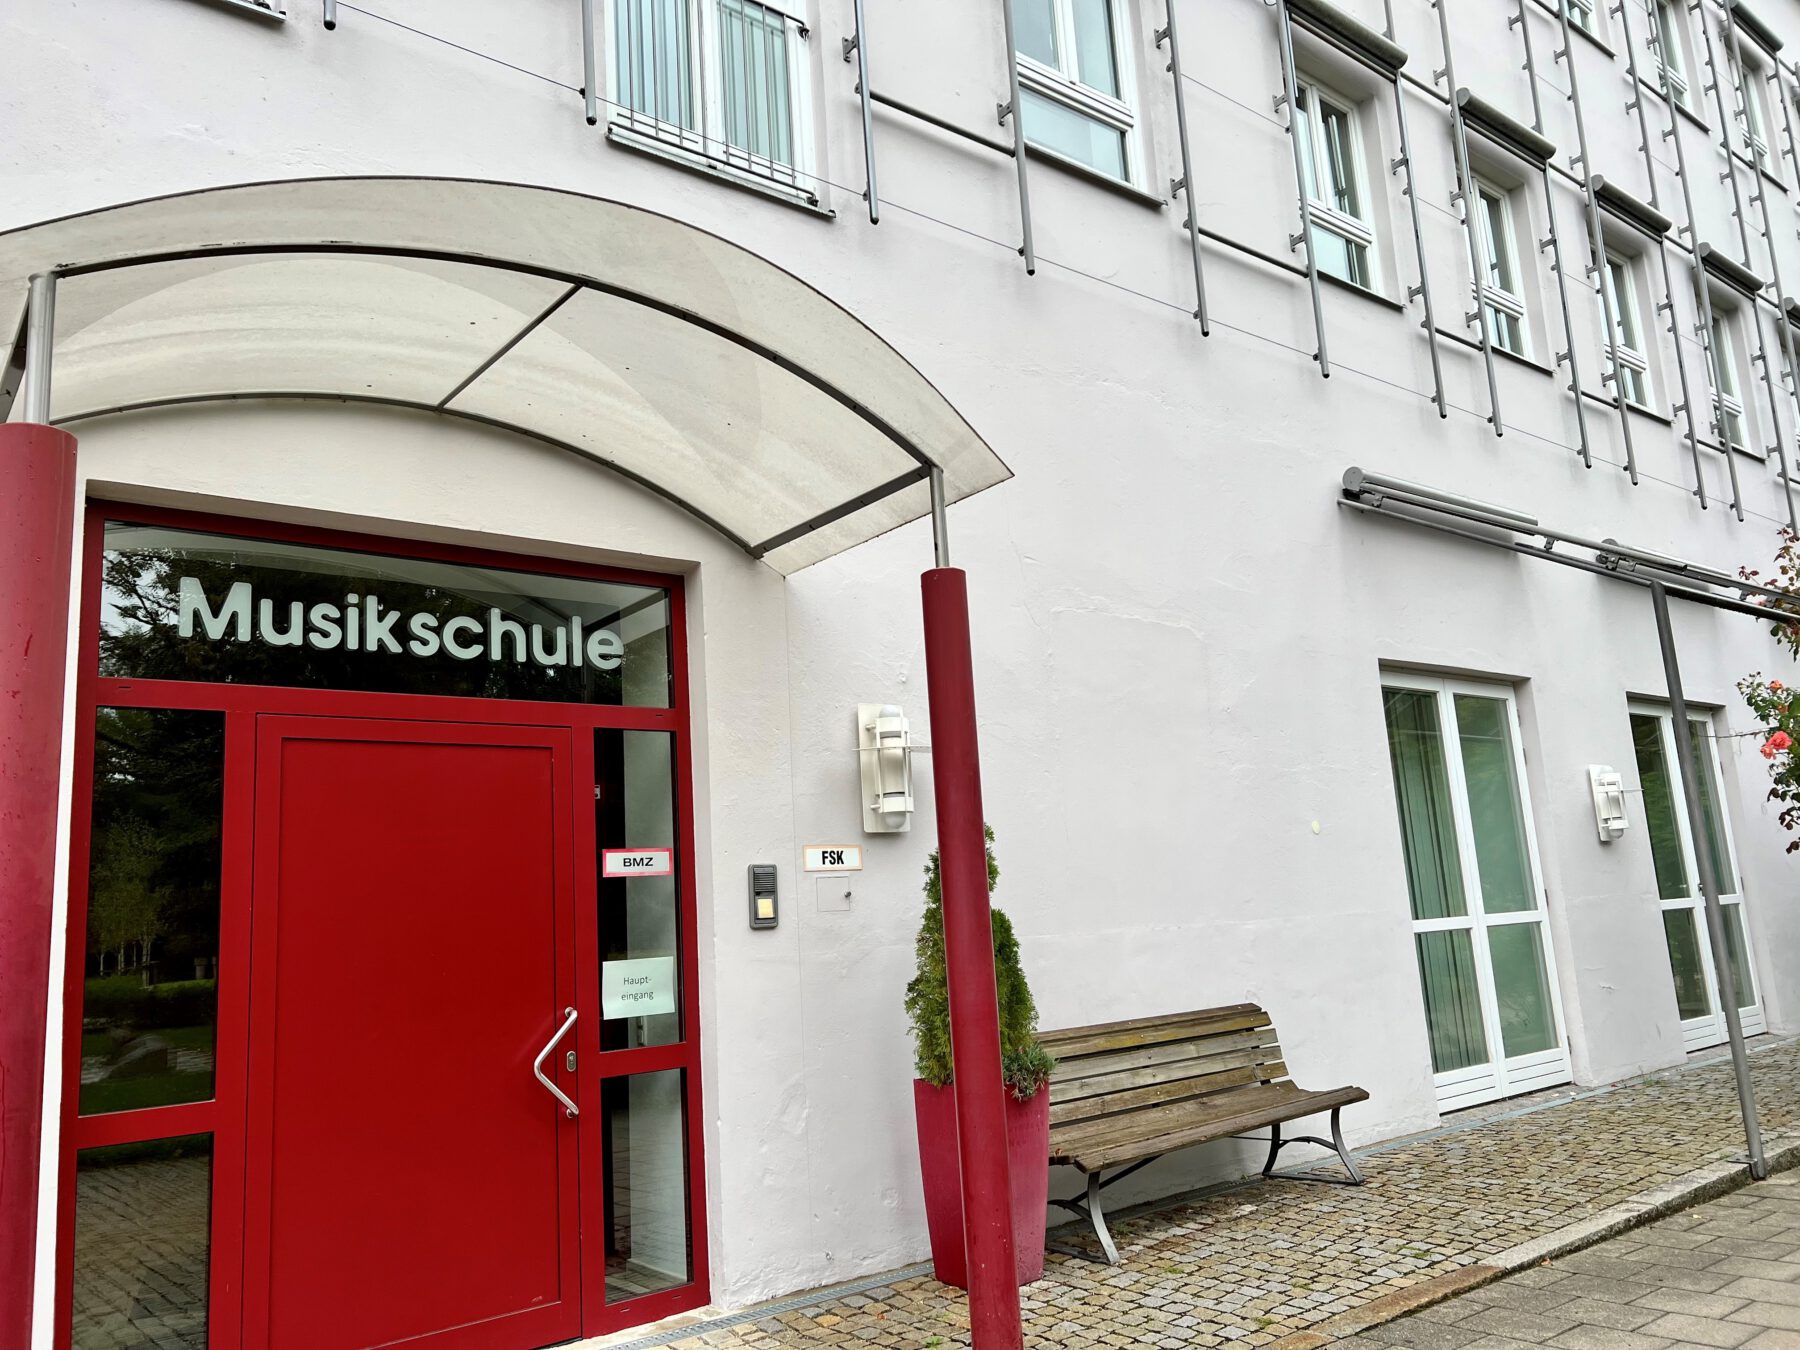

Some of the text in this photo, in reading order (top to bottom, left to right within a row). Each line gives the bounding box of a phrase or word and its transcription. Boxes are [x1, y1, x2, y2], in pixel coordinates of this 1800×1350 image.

[177, 576, 625, 671] Musikschule
[622, 856, 654, 868] BMZ
[821, 849, 845, 866] FSK
[623, 976, 652, 986] Haupt-
[621, 991, 654, 1001] eingang
